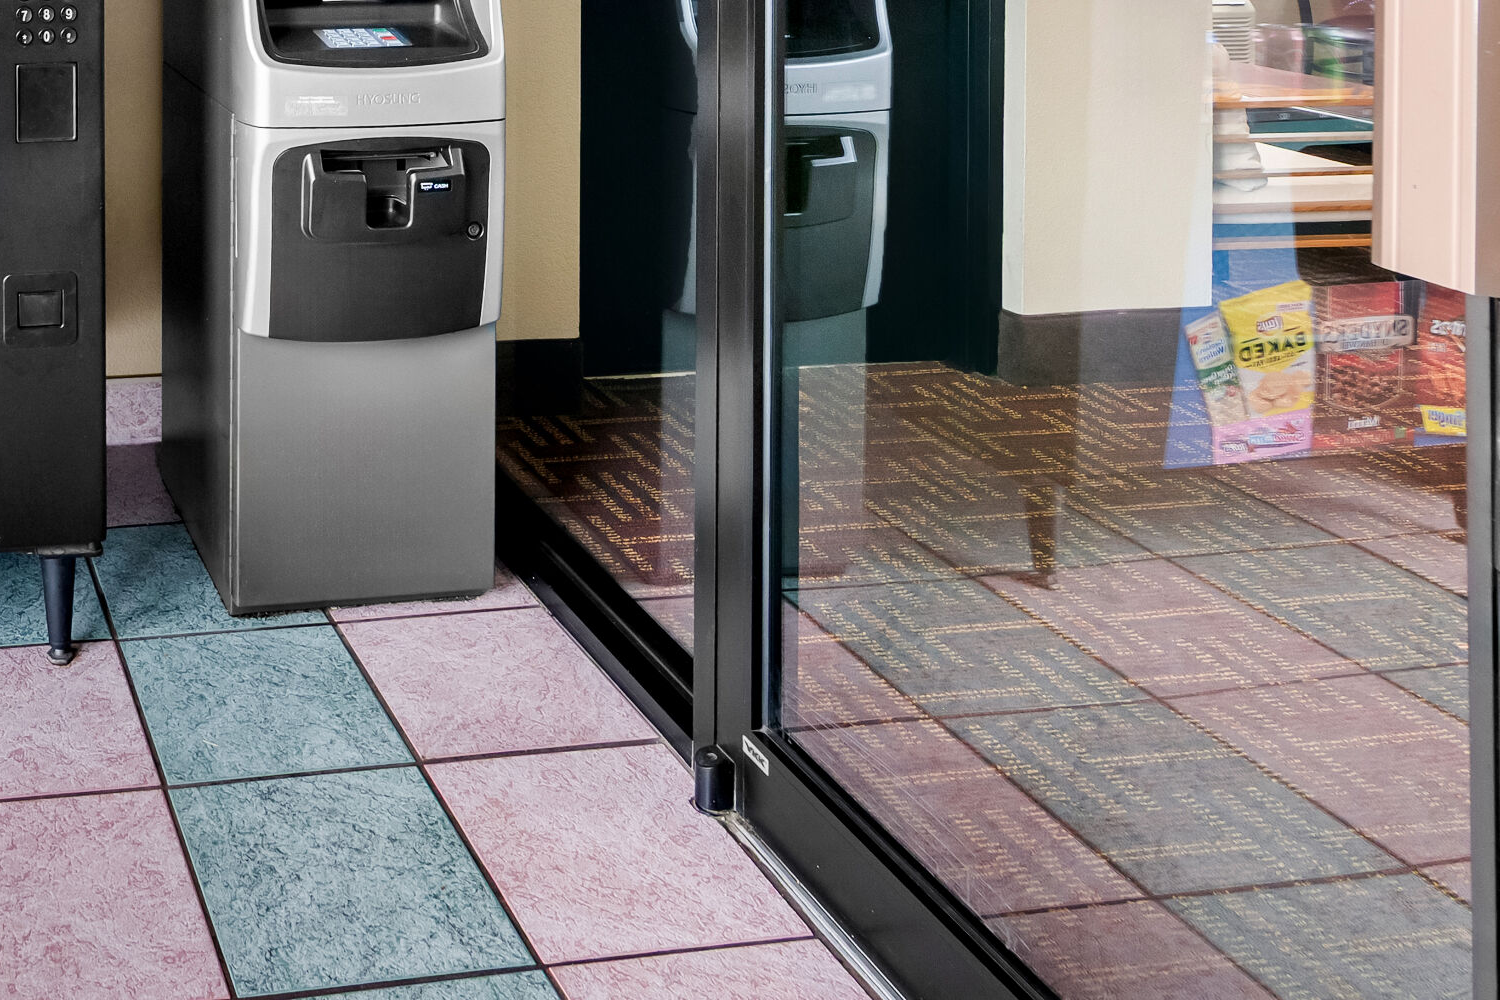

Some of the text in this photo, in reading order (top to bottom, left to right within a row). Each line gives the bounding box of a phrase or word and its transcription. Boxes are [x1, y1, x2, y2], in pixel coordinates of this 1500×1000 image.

[21, 10, 28, 21] 7
[43, 9, 50, 20] 8
[66, 8, 72, 20] 9
[43, 31, 50, 42] 0
[357, 93, 421, 105] HYOSUNG
